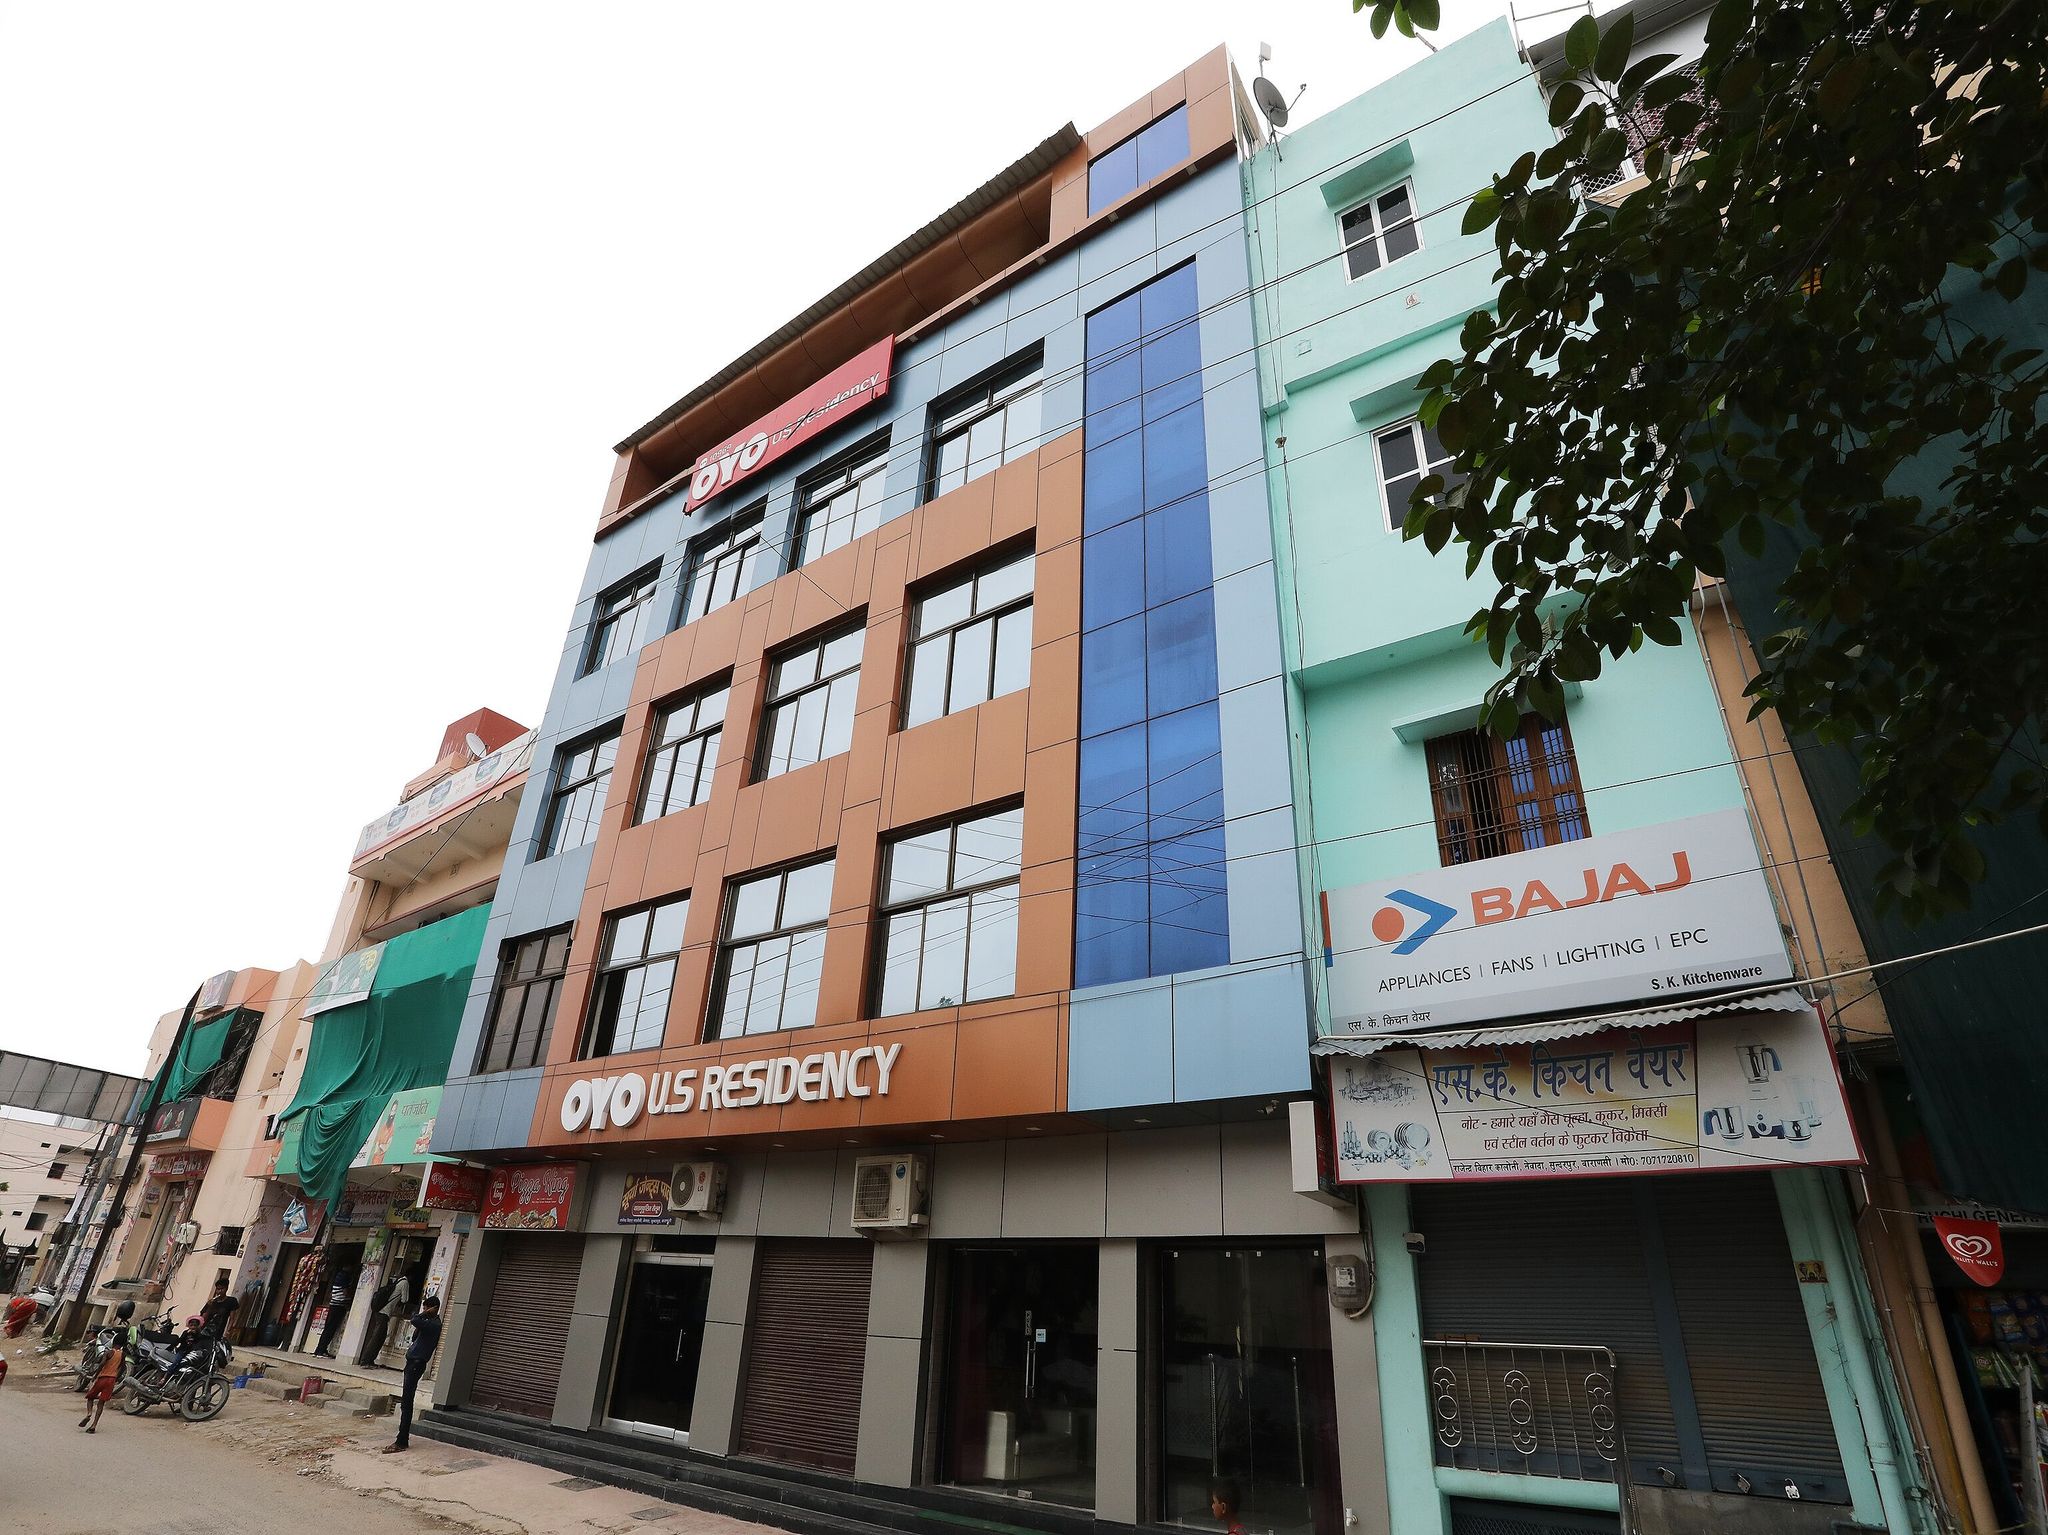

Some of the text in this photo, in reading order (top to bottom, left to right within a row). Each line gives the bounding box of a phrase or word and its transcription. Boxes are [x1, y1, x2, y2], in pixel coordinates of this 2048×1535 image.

[692, 432, 769, 499] OYO
[797, 371, 880, 427] Residency
[1471, 851, 1692, 926] BAJAJ
[1378, 928, 1709, 993] APPLIANCES FANS LIGHTING EPC
[1651, 965, 1763, 990] S. K. Kitchenware
[1383, 1013, 1409, 1027] किचन
[1412, 1010, 1431, 1022] वेयर
[1530, 1041, 1615, 1099] किचन
[1624, 1034, 1689, 1089] वेयर
[560, 1072, 647, 1132] OYO
[699, 1043, 904, 1112] RESIDENCY
[1461, 1114, 1479, 1130] नोट
[1491, 1112, 1515, 1129] हमारे
[1540, 1111, 1560, 1125] गैस
[1632, 1102, 1668, 1119] मिक्सी
[1484, 1136, 1498, 1150] एवं
[1502, 1133, 1527, 1149] स्टील
[1530, 1131, 1555, 1147] बर्तन
[1558, 1131, 1570, 1146] के
[1573, 1132, 1609, 1149] फुटकर
[1640, 1153, 1695, 1166] 7071720810
[511, 1166, 569, 1205] Pizza King
